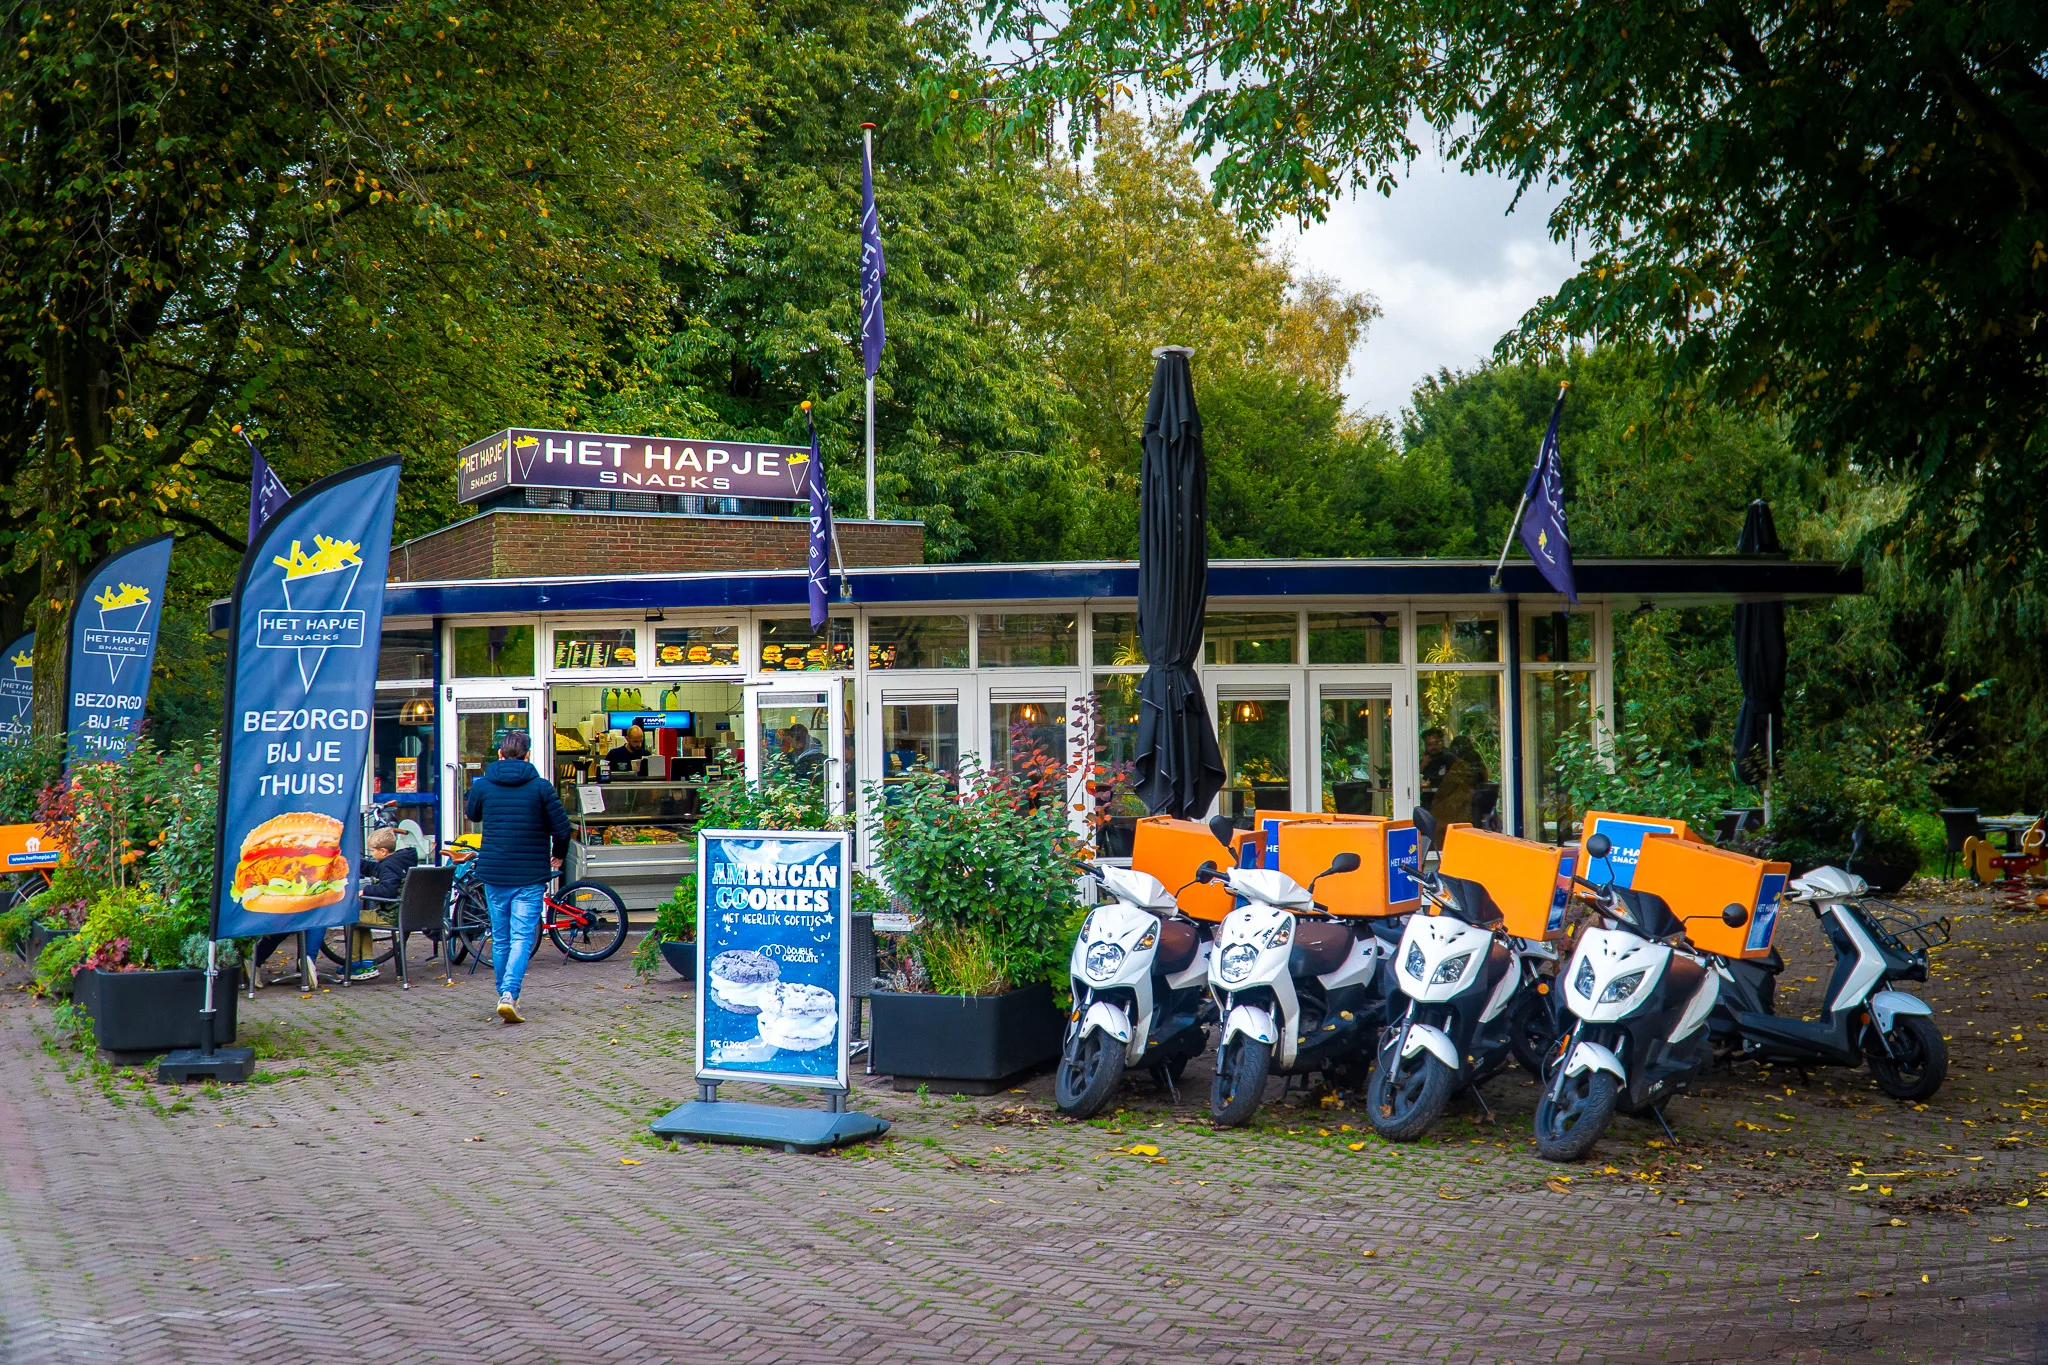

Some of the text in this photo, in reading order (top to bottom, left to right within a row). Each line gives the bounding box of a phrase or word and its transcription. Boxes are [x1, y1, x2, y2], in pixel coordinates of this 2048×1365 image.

[465, 442, 503, 474] HET HAPJE
[545, 438, 781, 477] HET HAPJE
[470, 470, 498, 490] SNACKS
[599, 471, 731, 490] SNACKS
[263, 618, 359, 630] HET HAPJE
[86, 634, 149, 646] HET HAPJE
[282, 633, 339, 641] SNACKS
[98, 644, 136, 652] SNACKS
[74, 692, 142, 710] BEZORGD
[88, 714, 110, 729] BIJ
[243, 708, 368, 732] BEZORGD
[266, 740, 342, 765] BIJ JE
[258, 773, 344, 797] THUIS!
[1390, 858, 1401, 868] HET
[712, 862, 838, 889] AMERICAN
[716, 887, 829, 912] COOKIES
[722, 912, 822, 927] MET HEERLIJK SOFTIJS
[782, 954, 819, 964] CHOCOLATE
